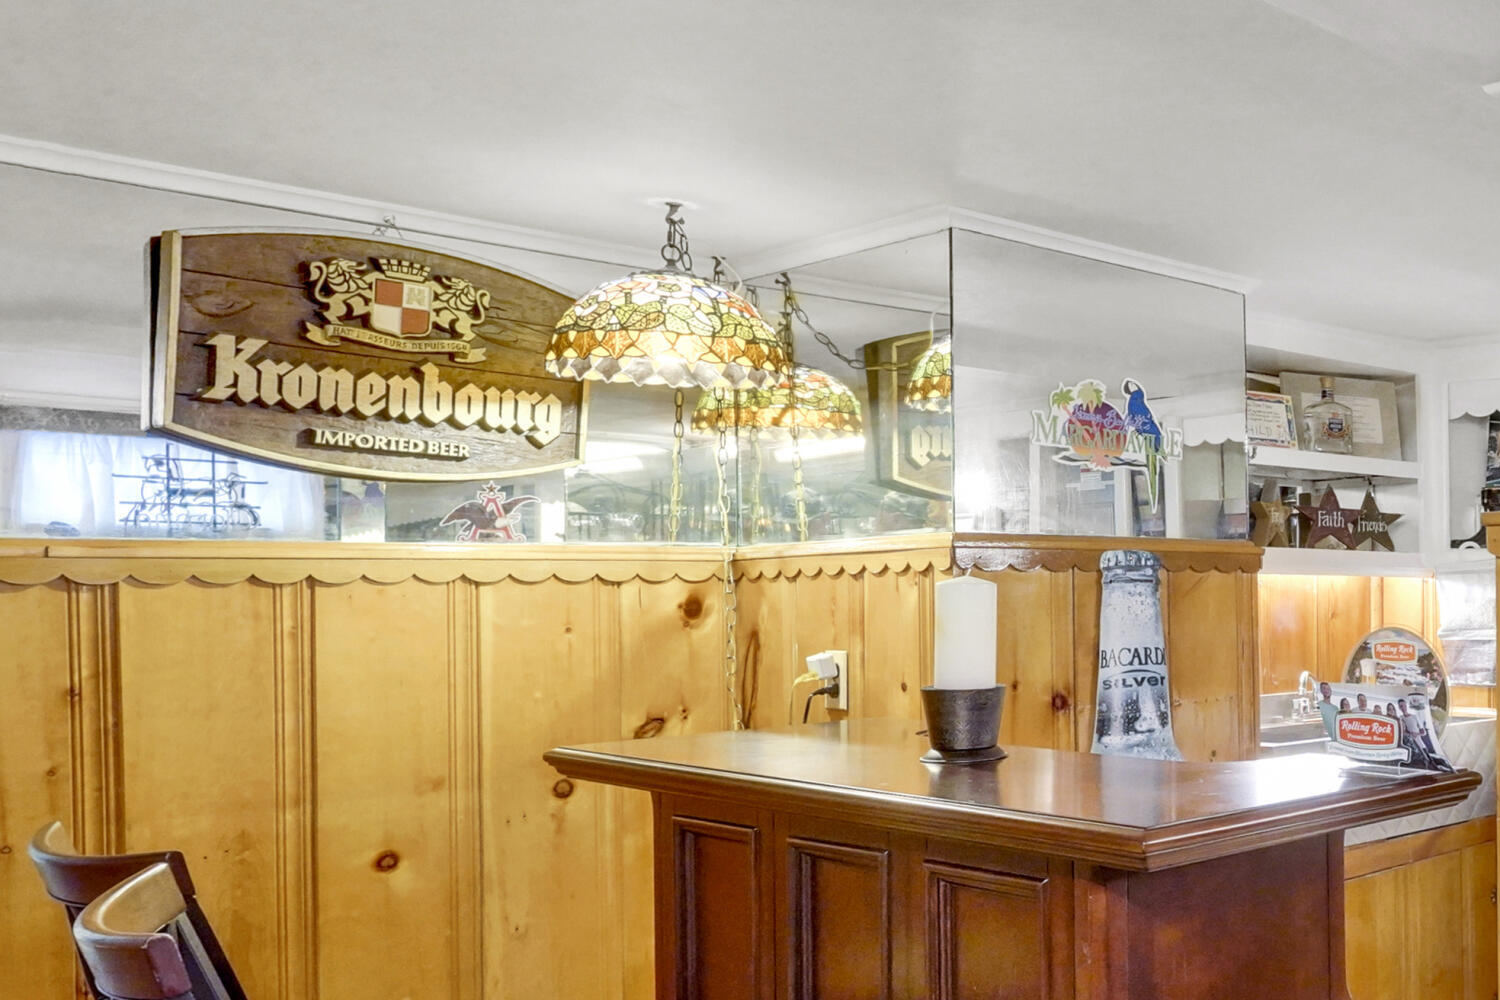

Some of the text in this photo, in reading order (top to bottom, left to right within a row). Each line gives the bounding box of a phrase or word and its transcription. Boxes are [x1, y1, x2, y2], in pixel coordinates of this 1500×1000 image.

[411, 342, 445, 351] DEPUIS
[201, 333, 563, 438] Kronenbourg
[315, 429, 471, 459] IMPORTED BEER
[1317, 510, 1345, 528] Faith
[1100, 646, 1166, 669] BACARDI
[1375, 644, 1413, 654] Rolling Rock
[1341, 720, 1392, 734] Rolling Rock
